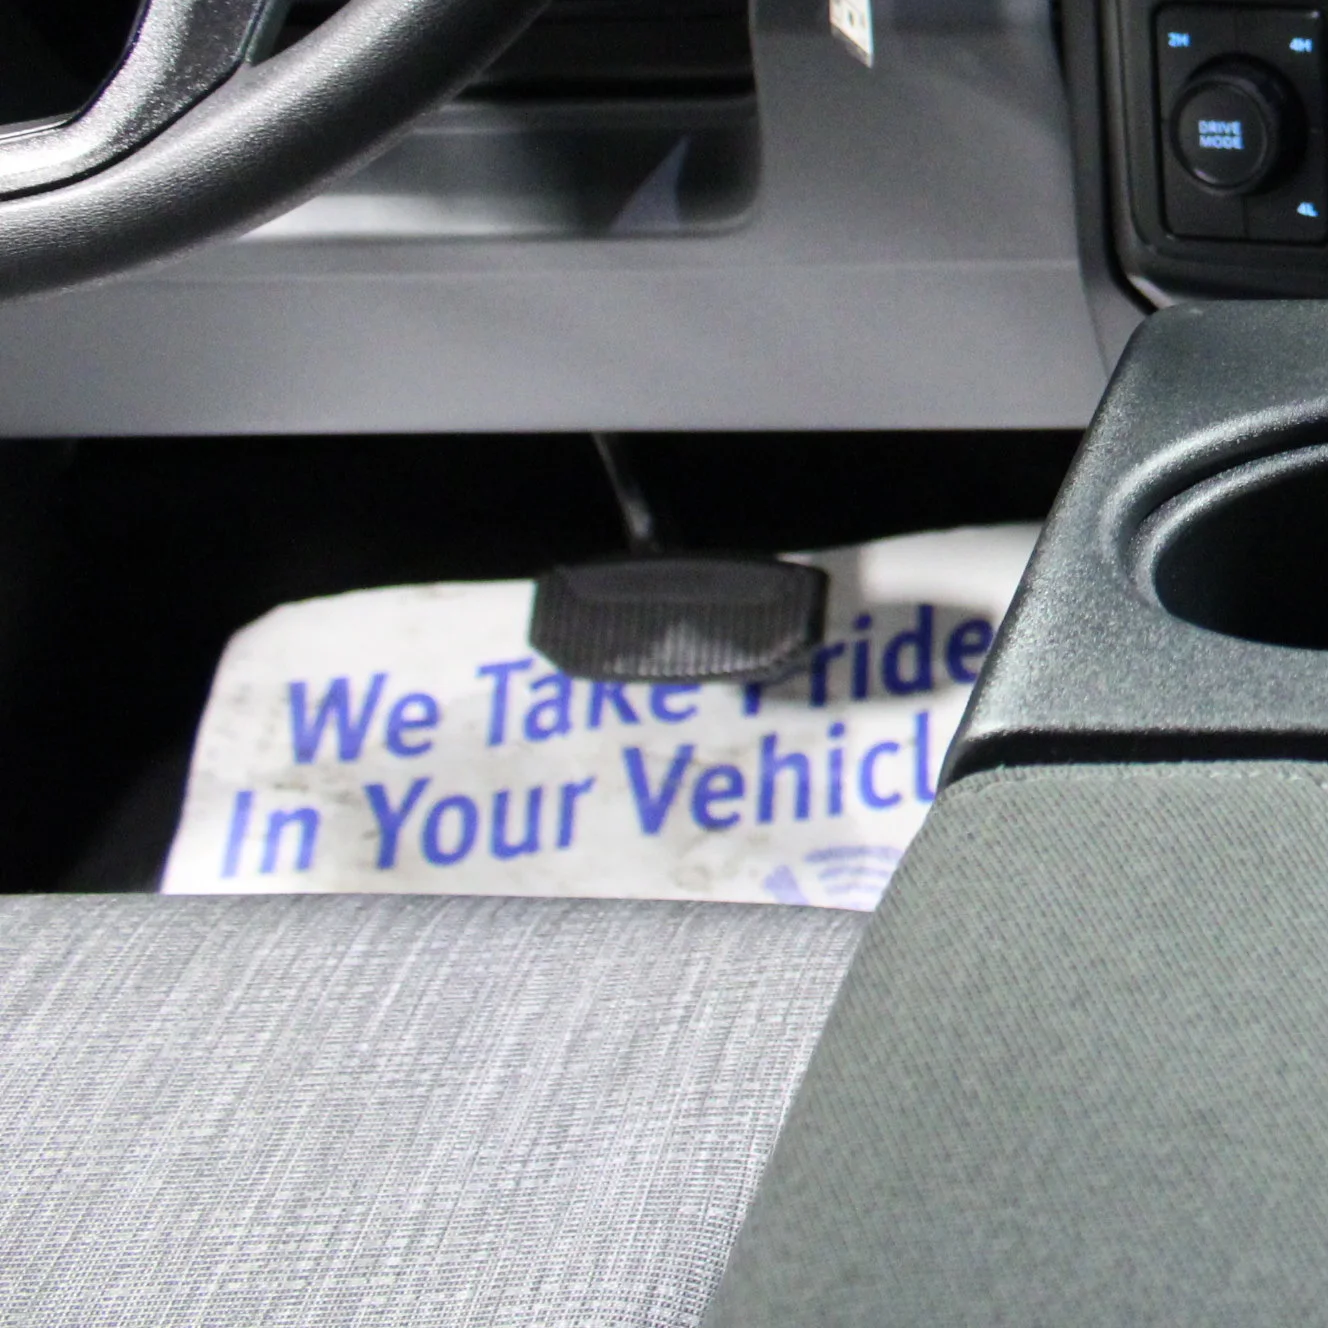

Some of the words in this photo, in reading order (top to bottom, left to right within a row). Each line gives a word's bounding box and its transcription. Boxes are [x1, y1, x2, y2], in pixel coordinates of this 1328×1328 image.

[1167, 32, 1191, 47] 2H
[1289, 37, 1313, 52] 4H
[1198, 120, 1243, 135] DRIVE
[1199, 135, 1245, 150] MODE
[1297, 202, 1318, 218] 4L
[288, 671, 441, 765] We
[220, 789, 321, 879] In
[364, 776, 596, 872] Your
[622, 709, 936, 838] Vehicl
